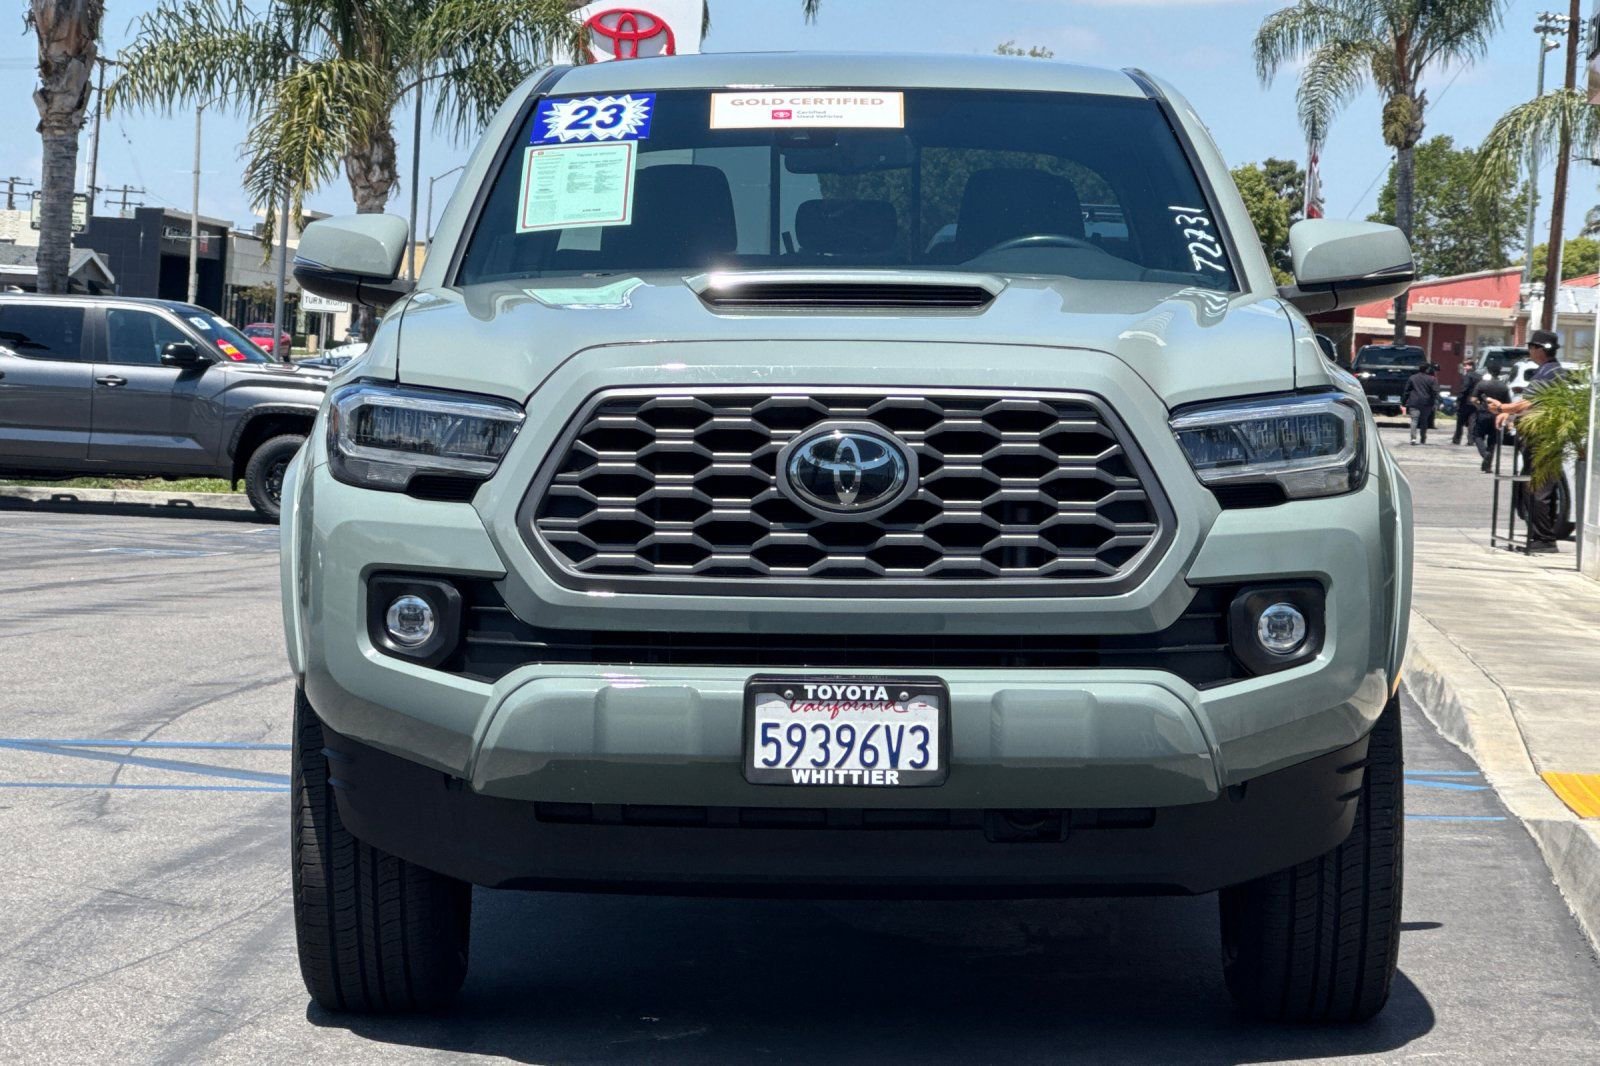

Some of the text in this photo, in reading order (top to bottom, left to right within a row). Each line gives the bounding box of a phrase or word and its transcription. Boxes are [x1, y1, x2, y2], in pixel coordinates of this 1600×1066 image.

[730, 97, 885, 106] GOLD CERTIFIED
[565, 104, 626, 130] 23
[305, 296, 323, 304] TURN
[1418, 296, 1502, 308] EAST WHITTIER CITY
[804, 685, 889, 700] TOYOTA
[789, 698, 909, 720] California
[761, 722, 930, 769] 59396V3
[792, 769, 899, 785] WHITTIER
